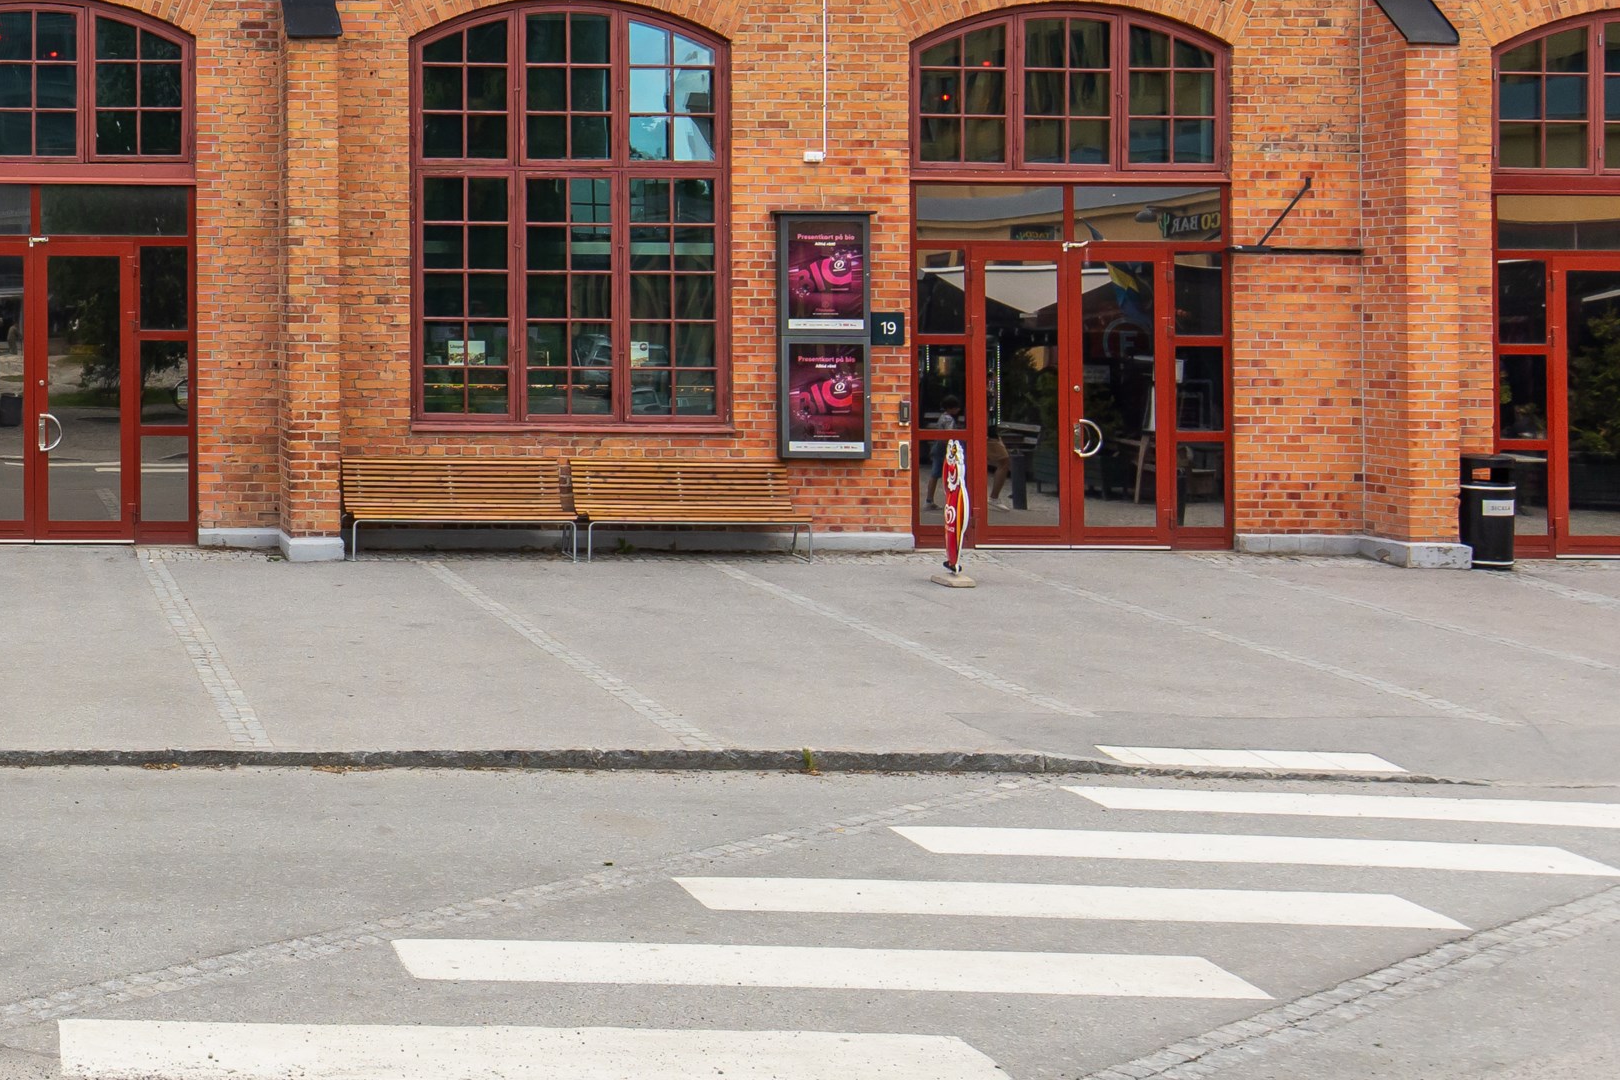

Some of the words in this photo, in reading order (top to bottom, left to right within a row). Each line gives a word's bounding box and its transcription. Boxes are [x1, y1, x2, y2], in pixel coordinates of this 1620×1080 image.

[835, 233, 843, 241] på
[880, 321, 897, 335] 19
[835, 355, 844, 363] på
